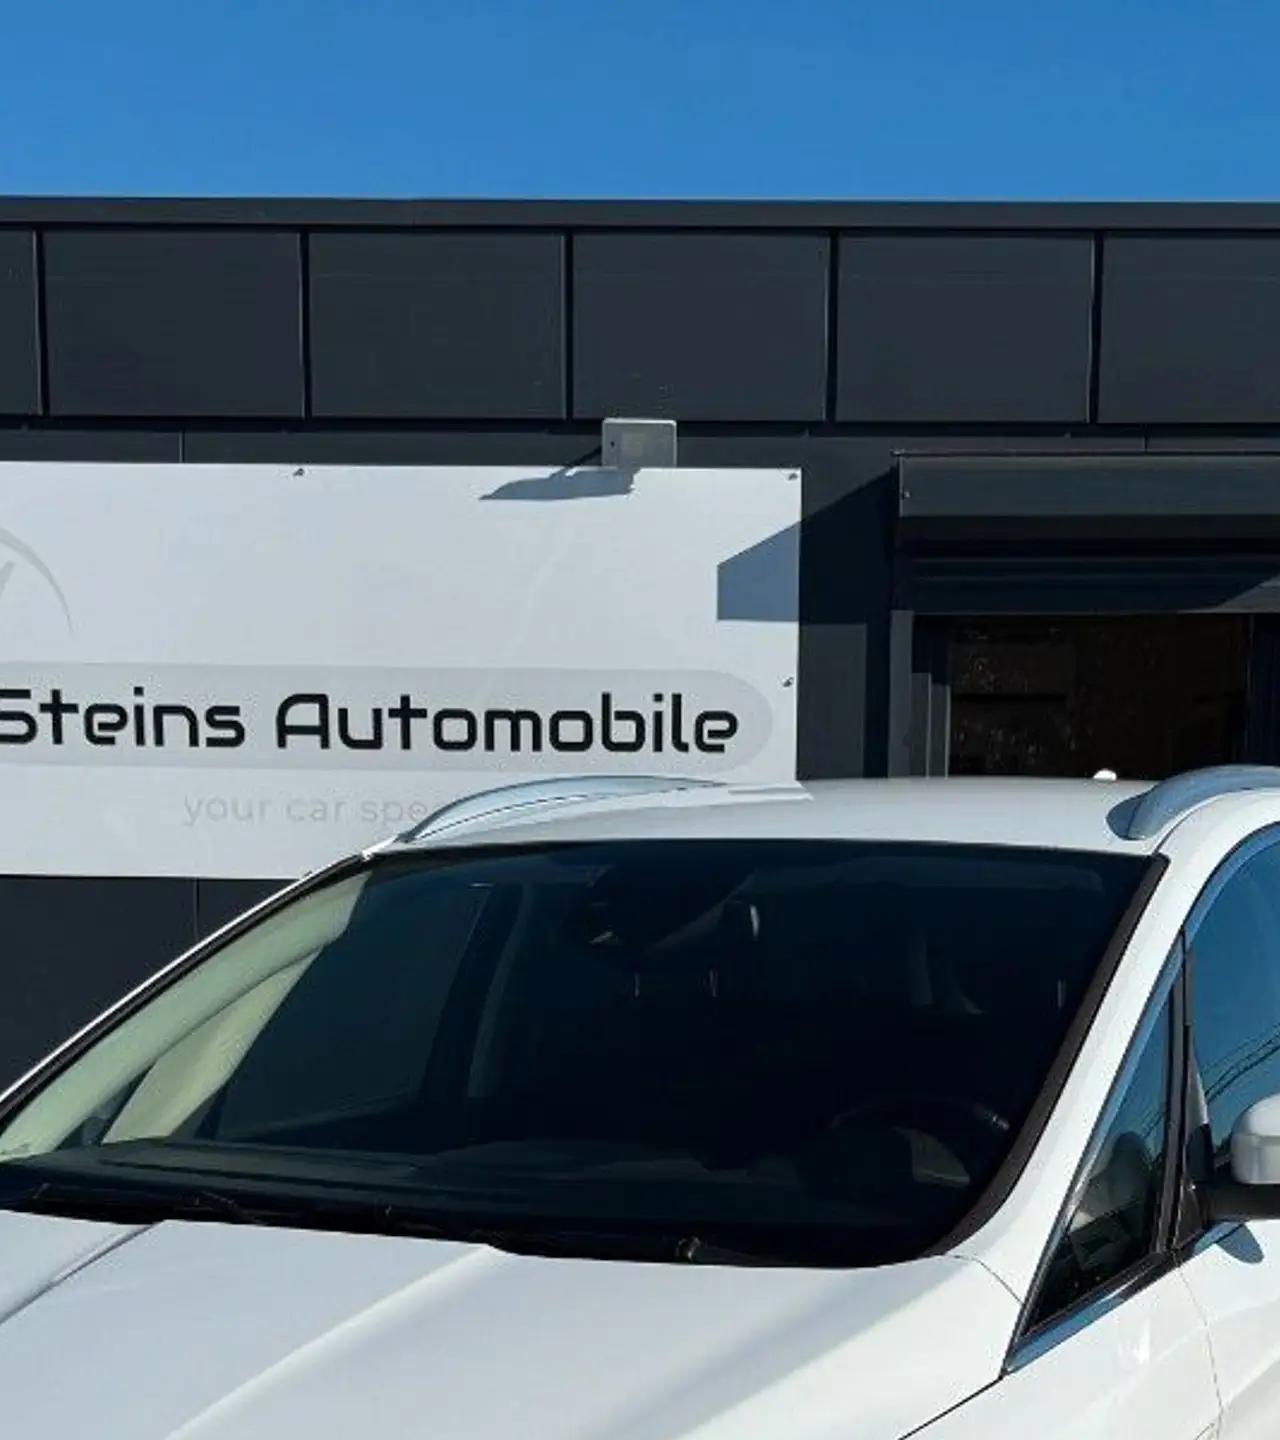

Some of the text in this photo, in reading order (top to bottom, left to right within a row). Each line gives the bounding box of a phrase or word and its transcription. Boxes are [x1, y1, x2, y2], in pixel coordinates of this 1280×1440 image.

[274, 692, 739, 753] Automobile
[183, 793, 274, 827] your
[285, 797, 348, 823] car
